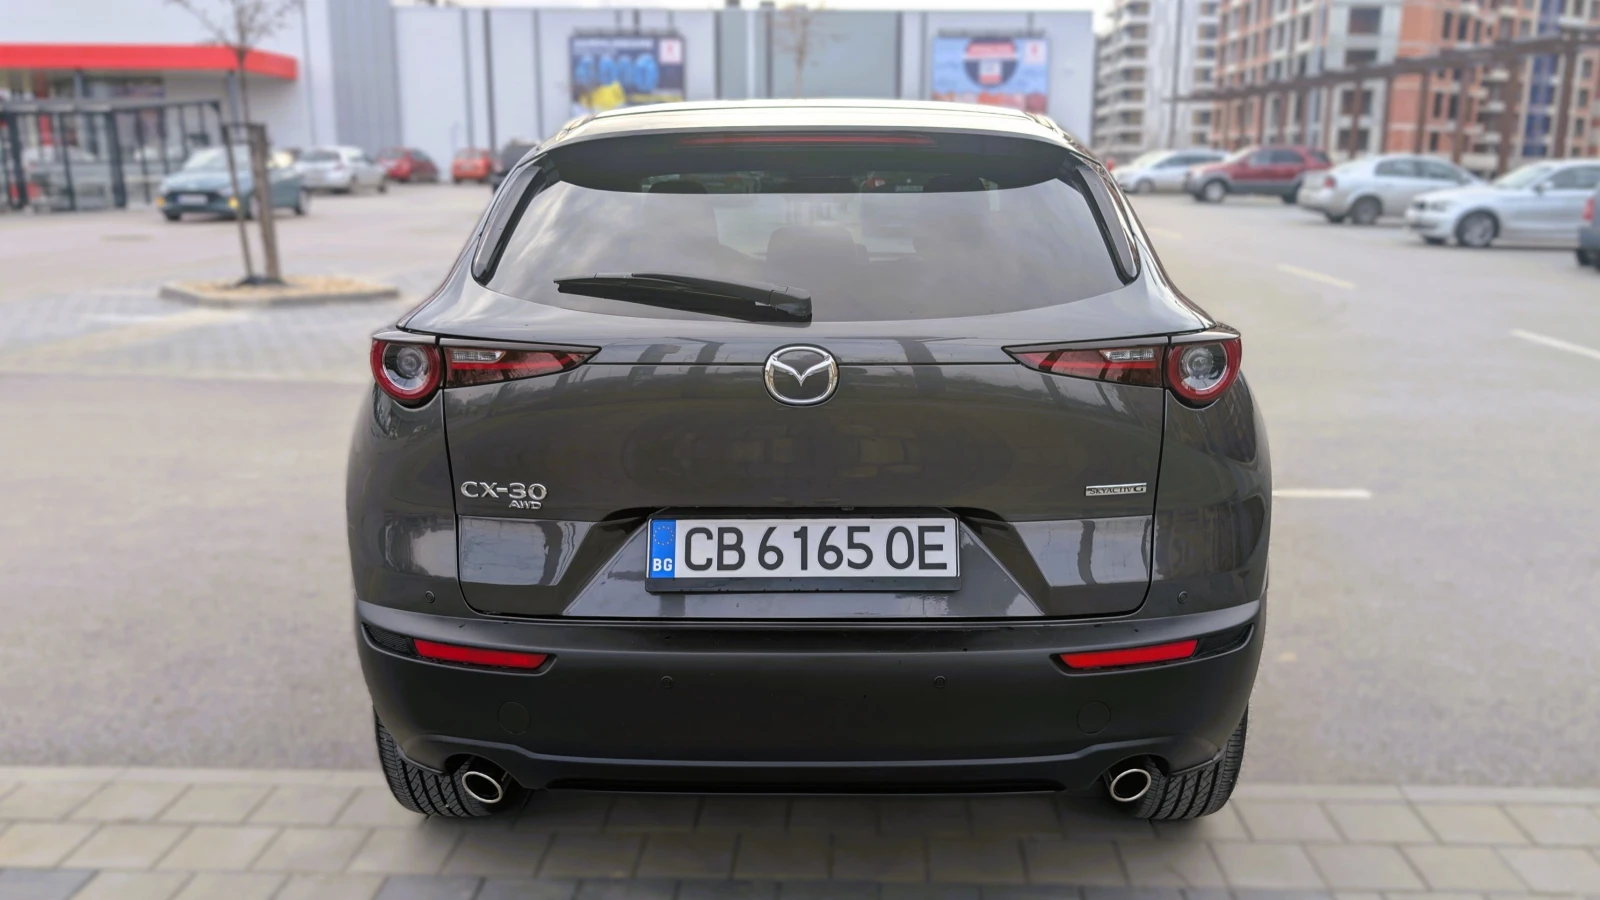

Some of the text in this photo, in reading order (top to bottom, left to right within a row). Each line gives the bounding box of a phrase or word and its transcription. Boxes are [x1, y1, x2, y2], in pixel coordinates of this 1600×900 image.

[460, 481, 548, 500] CX-30
[508, 500, 542, 509] AWD
[684, 526, 746, 571] CB
[757, 525, 874, 571] 6165
[652, 557, 673, 572] BG
